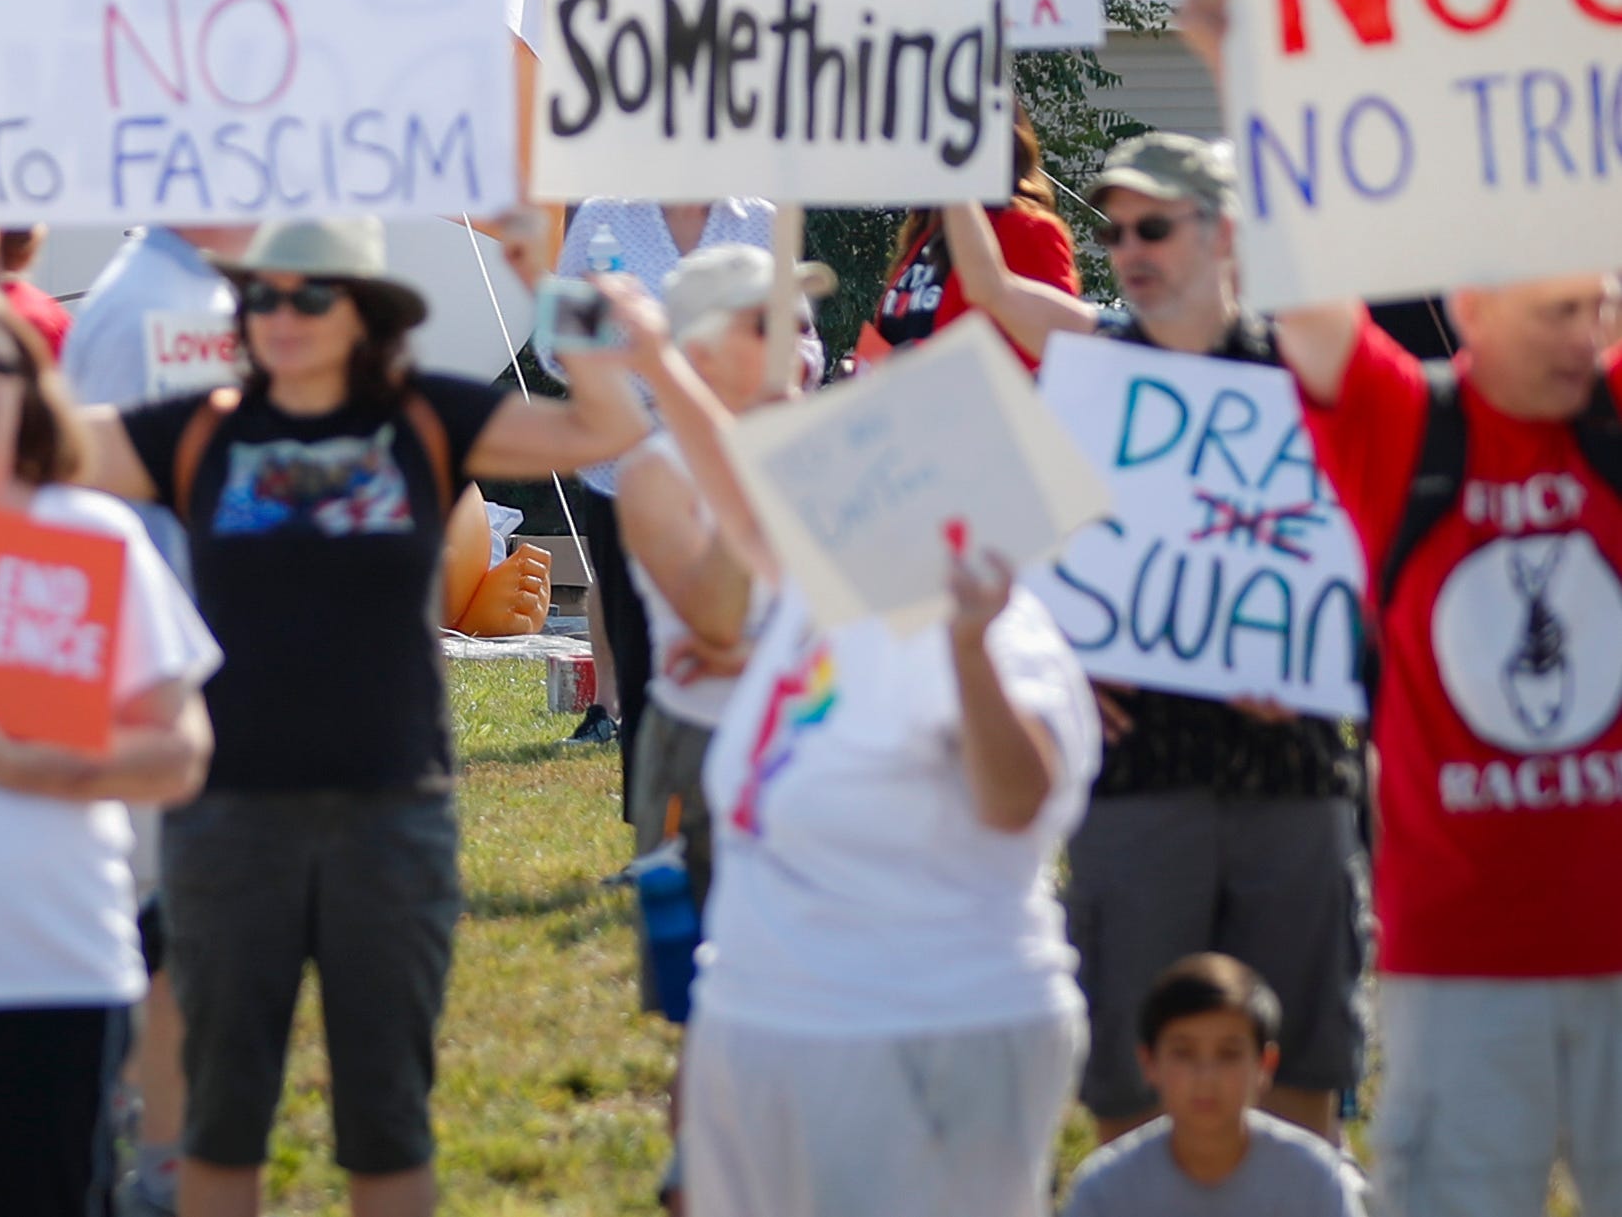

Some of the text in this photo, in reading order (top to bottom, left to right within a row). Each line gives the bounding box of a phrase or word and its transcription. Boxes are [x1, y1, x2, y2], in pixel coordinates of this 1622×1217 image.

[111, 108, 485, 211] FASCISM
[1247, 64, 1622, 218] NO TRI
[1438, 749, 1622, 814] RACIS
